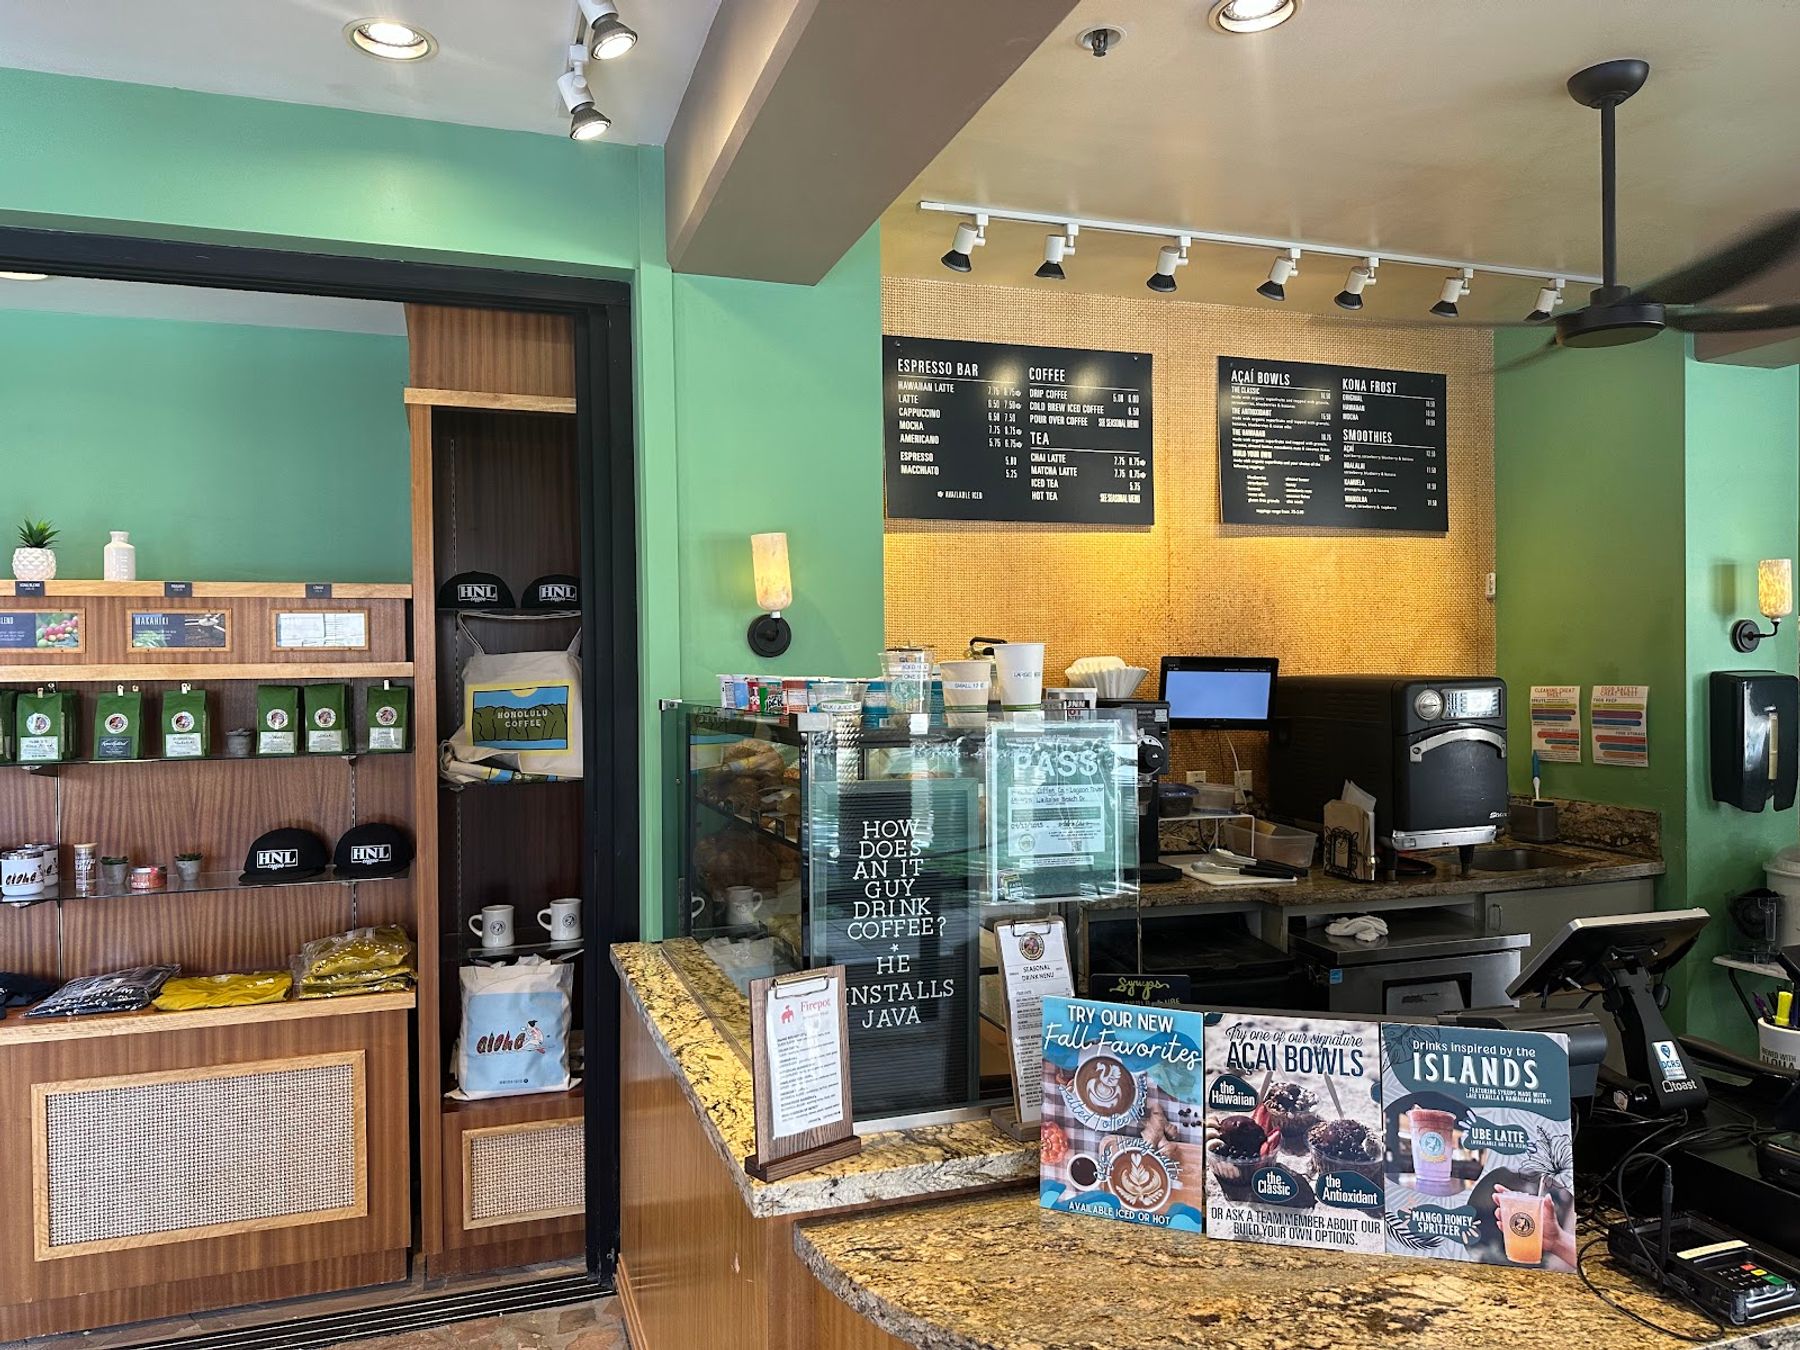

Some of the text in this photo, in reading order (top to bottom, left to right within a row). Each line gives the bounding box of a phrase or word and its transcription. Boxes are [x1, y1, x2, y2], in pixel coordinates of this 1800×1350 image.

[897, 358, 979, 377] ESPRESSO BAR
[1028, 367, 1066, 382] COFFEE
[1231, 368, 1290, 386] AÇAÍ BOWLS
[934, 383, 955, 393] LATTE
[1342, 378, 1398, 394] KONA FROST
[898, 394, 919, 404] LATTE
[1004, 400, 1016, 410] 7.50
[1029, 389, 1044, 398] DRIP
[1046, 390, 1068, 400] COFFEE
[898, 407, 941, 418] CAPPUCCINO
[1004, 413, 1016, 422] 7.50
[1029, 402, 1105, 414] COLD BREW ICED COFFEE
[899, 420, 1000, 435] MOCHA 7.75
[1030, 414, 1047, 424] POUR
[1048, 416, 1065, 425] OVER
[1066, 416, 1088, 426] COFFEE
[900, 433, 940, 445] AMERICANO
[988, 438, 1001, 448] 5.75
[1030, 432, 1050, 445] TEA
[1342, 428, 1393, 444] SMOOTHIES
[900, 452, 934, 462] ESPRESSO
[1030, 453, 1125, 466] CHAI LATTE 7.75
[900, 464, 940, 476] MACCHIATO
[1030, 466, 1126, 478] MATCHA LATTE 7.75
[1031, 478, 1045, 488] ICED
[1046, 479, 1058, 488] TEA
[1031, 491, 1044, 500] HOT
[1046, 492, 1058, 501] TEA
[460, 586, 496, 598] HNL
[542, 586, 575, 598] HNL
[135, 616, 169, 626] MAKAHIKI
[496, 709, 549, 720] HONOLULU
[505, 719, 542, 728] COFFEE
[1014, 750, 1098, 777] PASS
[862, 819, 920, 840] HOW
[352, 847, 389, 860] HNL
[858, 839, 922, 859] DOES
[258, 852, 296, 865] HNL
[852, 859, 924, 880] AN IT
[864, 878, 916, 898] GUY
[853, 897, 932, 920] DRINK
[847, 916, 947, 940] COFFEE?
[876, 954, 910, 975] HE
[800, 998, 831, 1012] Firepot
[862, 1006, 922, 1028] JAVA
[1068, 1004, 1174, 1033] TRY OUR NEW
[476, 1030, 526, 1054] aloha
[1225, 1022, 1364, 1050] Try one of our signature
[1044, 1022, 1203, 1071] Fall Favorites
[1412, 1040, 1536, 1058] Drinks inspired by the
[1226, 1042, 1364, 1077] AÇAI BOWLS
[1412, 1052, 1540, 1090] ISLANDS
[1220, 1080, 1236, 1095] the
[1672, 1079, 1698, 1092] toast
[1212, 1091, 1256, 1108] Hawaiian
[1472, 1127, 1524, 1143] UBE LATTE
[1266, 1172, 1282, 1185] the
[1325, 1174, 1341, 1188] the
[1258, 1180, 1291, 1196] Classic
[1322, 1188, 1378, 1206] Antioxidant
[1068, 1201, 1171, 1226] AVAILABLE ICED OR HOT
[1211, 1207, 1382, 1234] OR ASK A TEAM MEMBER ABOUT OUR
[1412, 1210, 1473, 1228] MANGO HONEY
[1234, 1222, 1358, 1246] BUILD YOUR OWN OPTIONS.
[1418, 1222, 1461, 1236] SPRITZER
